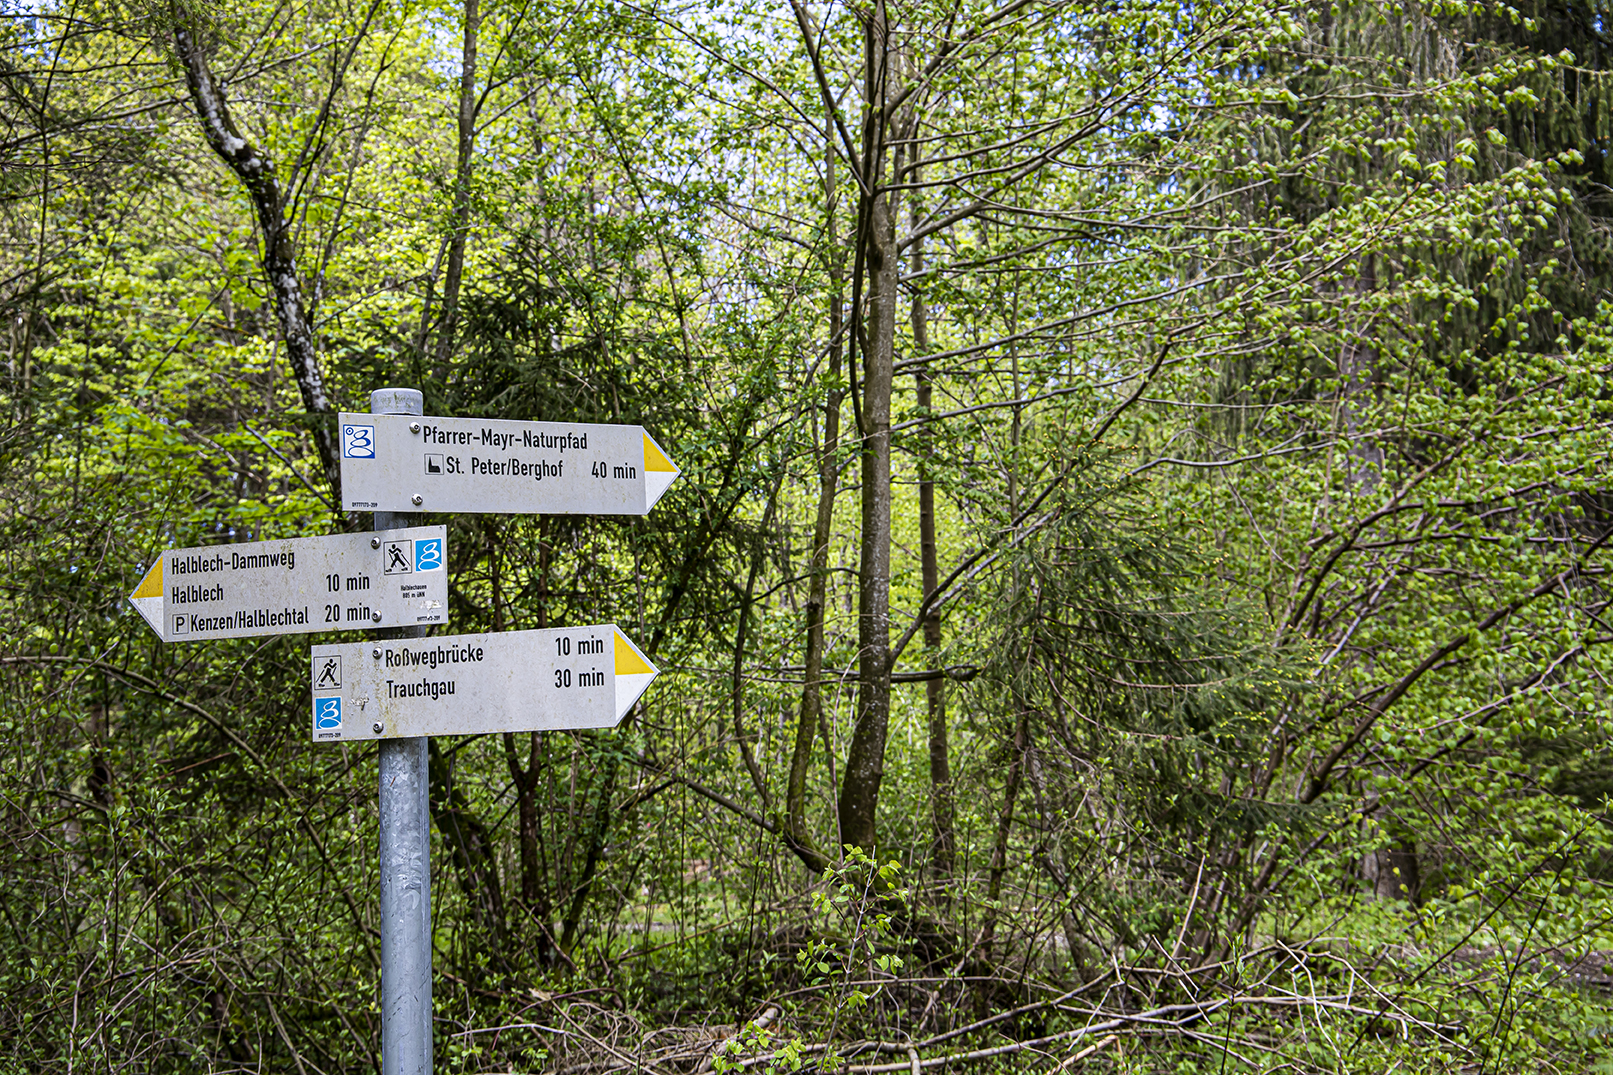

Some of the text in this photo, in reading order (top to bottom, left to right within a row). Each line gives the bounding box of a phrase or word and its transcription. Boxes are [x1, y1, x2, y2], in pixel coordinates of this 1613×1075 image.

[424, 426, 587, 453] Pfarrer-Mayr-Naturpfad
[447, 456, 636, 481] St. Peter/Berghof 40 min
[172, 550, 294, 575] Halblech-Dammweg
[172, 572, 369, 604] Halblech 10 min
[176, 603, 370, 632] P Kenzen/Halblechtal 20 min
[385, 635, 603, 669] Roßwegbrücke 10 min
[386, 668, 604, 700] Trauchgau 30 min
